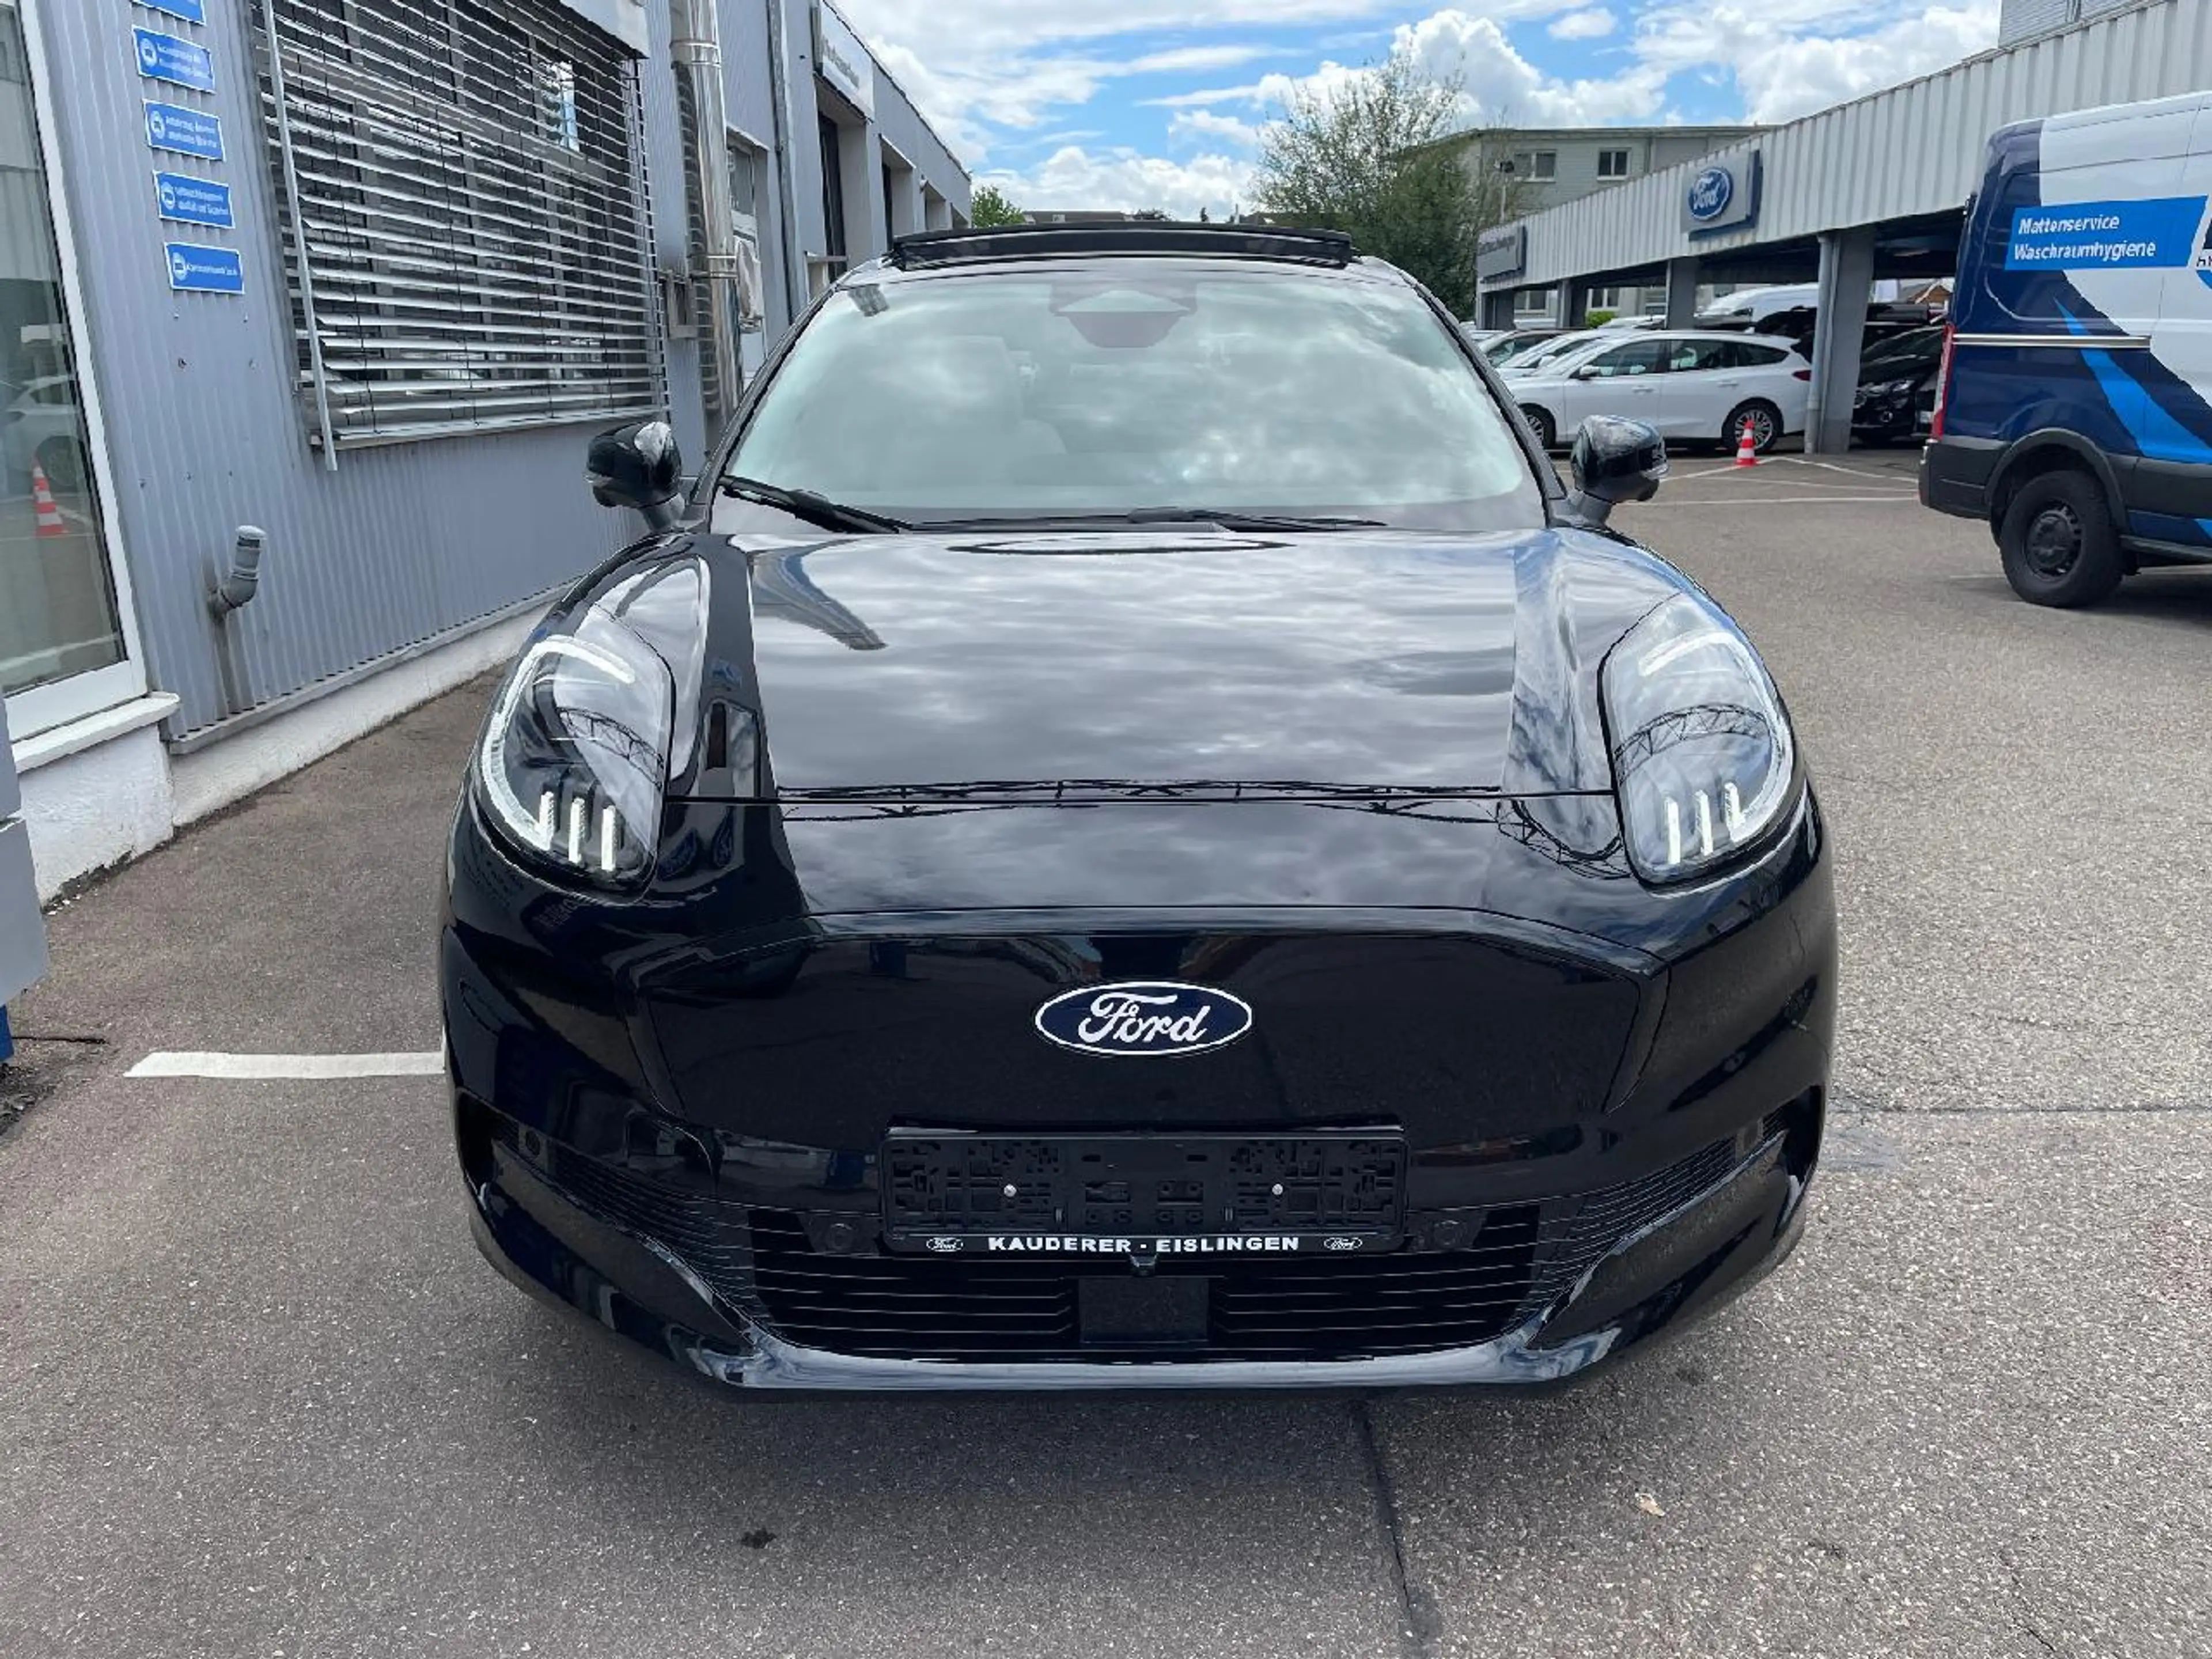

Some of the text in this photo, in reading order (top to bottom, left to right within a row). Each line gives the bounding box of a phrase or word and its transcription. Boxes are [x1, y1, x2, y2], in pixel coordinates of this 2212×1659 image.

[1694, 177, 1721, 210] Ford
[2018, 214, 2120, 235] Mattenservice
[2014, 240, 2156, 262] Waschraumhygiene
[1077, 992, 1211, 1043] Ford
[988, 1237, 1132, 1252] KAUDERER
[1156, 1237, 1299, 1252] EISLINGEN
